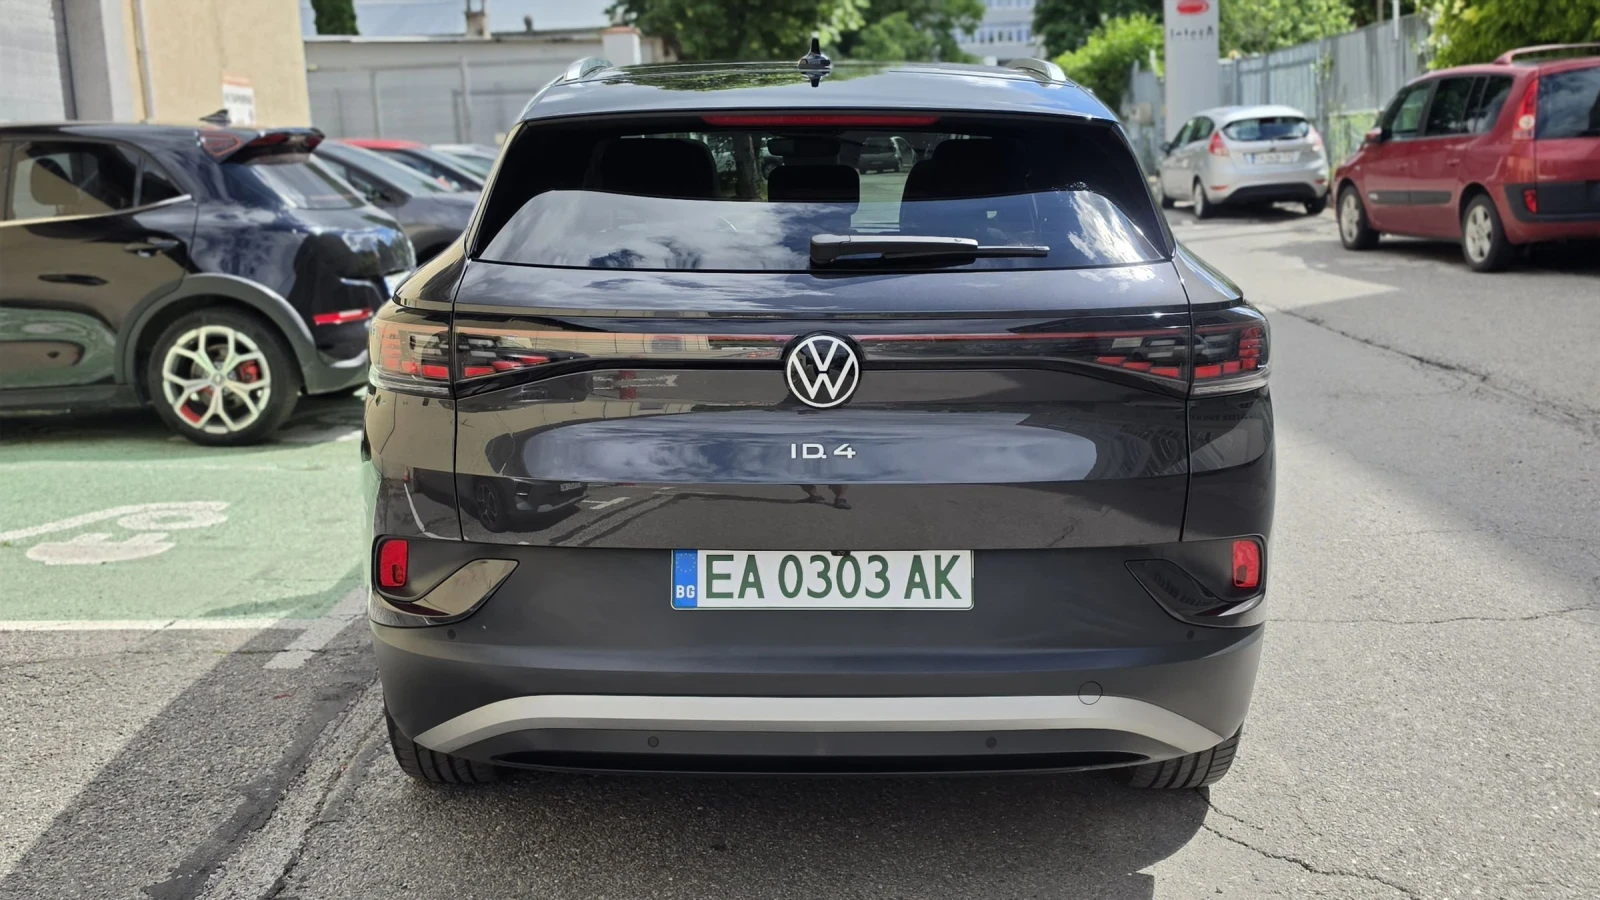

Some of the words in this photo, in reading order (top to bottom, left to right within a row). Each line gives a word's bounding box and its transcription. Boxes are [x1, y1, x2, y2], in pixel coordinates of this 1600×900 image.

[675, 584, 695, 599] BG
[705, 554, 765, 599] EA
[777, 554, 891, 599] 0303
[903, 554, 962, 600] AK
